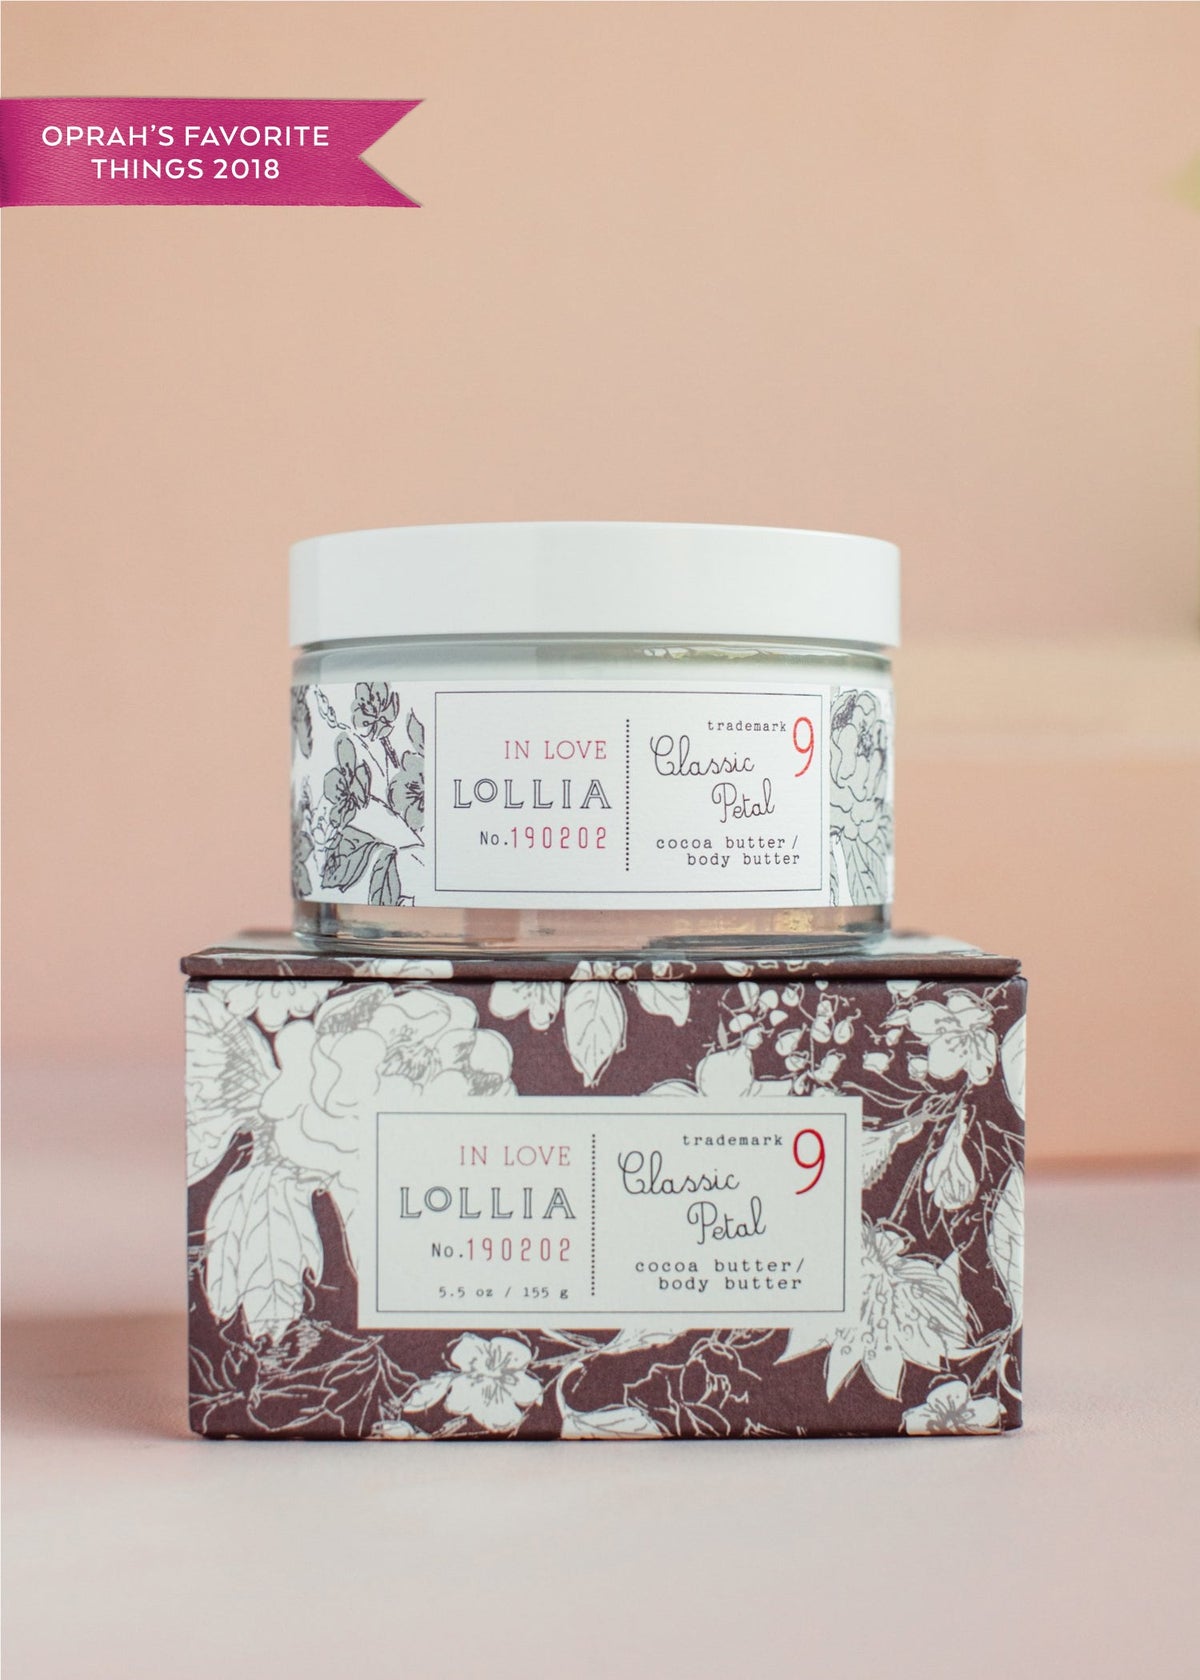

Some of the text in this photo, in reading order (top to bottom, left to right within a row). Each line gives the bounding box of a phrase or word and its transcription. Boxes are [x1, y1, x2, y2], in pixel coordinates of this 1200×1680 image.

[707, 720, 787, 732] trademark
[504, 739, 607, 760] IN LOVE
[649, 734, 756, 777] Classic
[792, 716, 815, 778] 9
[452, 777, 613, 810] LOLLIA
[711, 777, 776, 824] Petal
[656, 838, 713, 850] cocoa
[686, 851, 800, 869] body butter
[682, 1133, 783, 1147] trademark
[460, 1145, 571, 1167] IN LOVE
[791, 1127, 827, 1196] 9
[617, 1149, 741, 1196] Classic
[399, 1185, 577, 1220] LOLLIA
[686, 1195, 767, 1246] Petal
[634, 1261, 699, 1273] cocoa
[438, 1286, 466, 1298] 5.5
[475, 1288, 494, 1298] oz
[524, 1286, 550, 1299] 155
[559, 1288, 569, 1300] g
[658, 1275, 802, 1294] body butter
